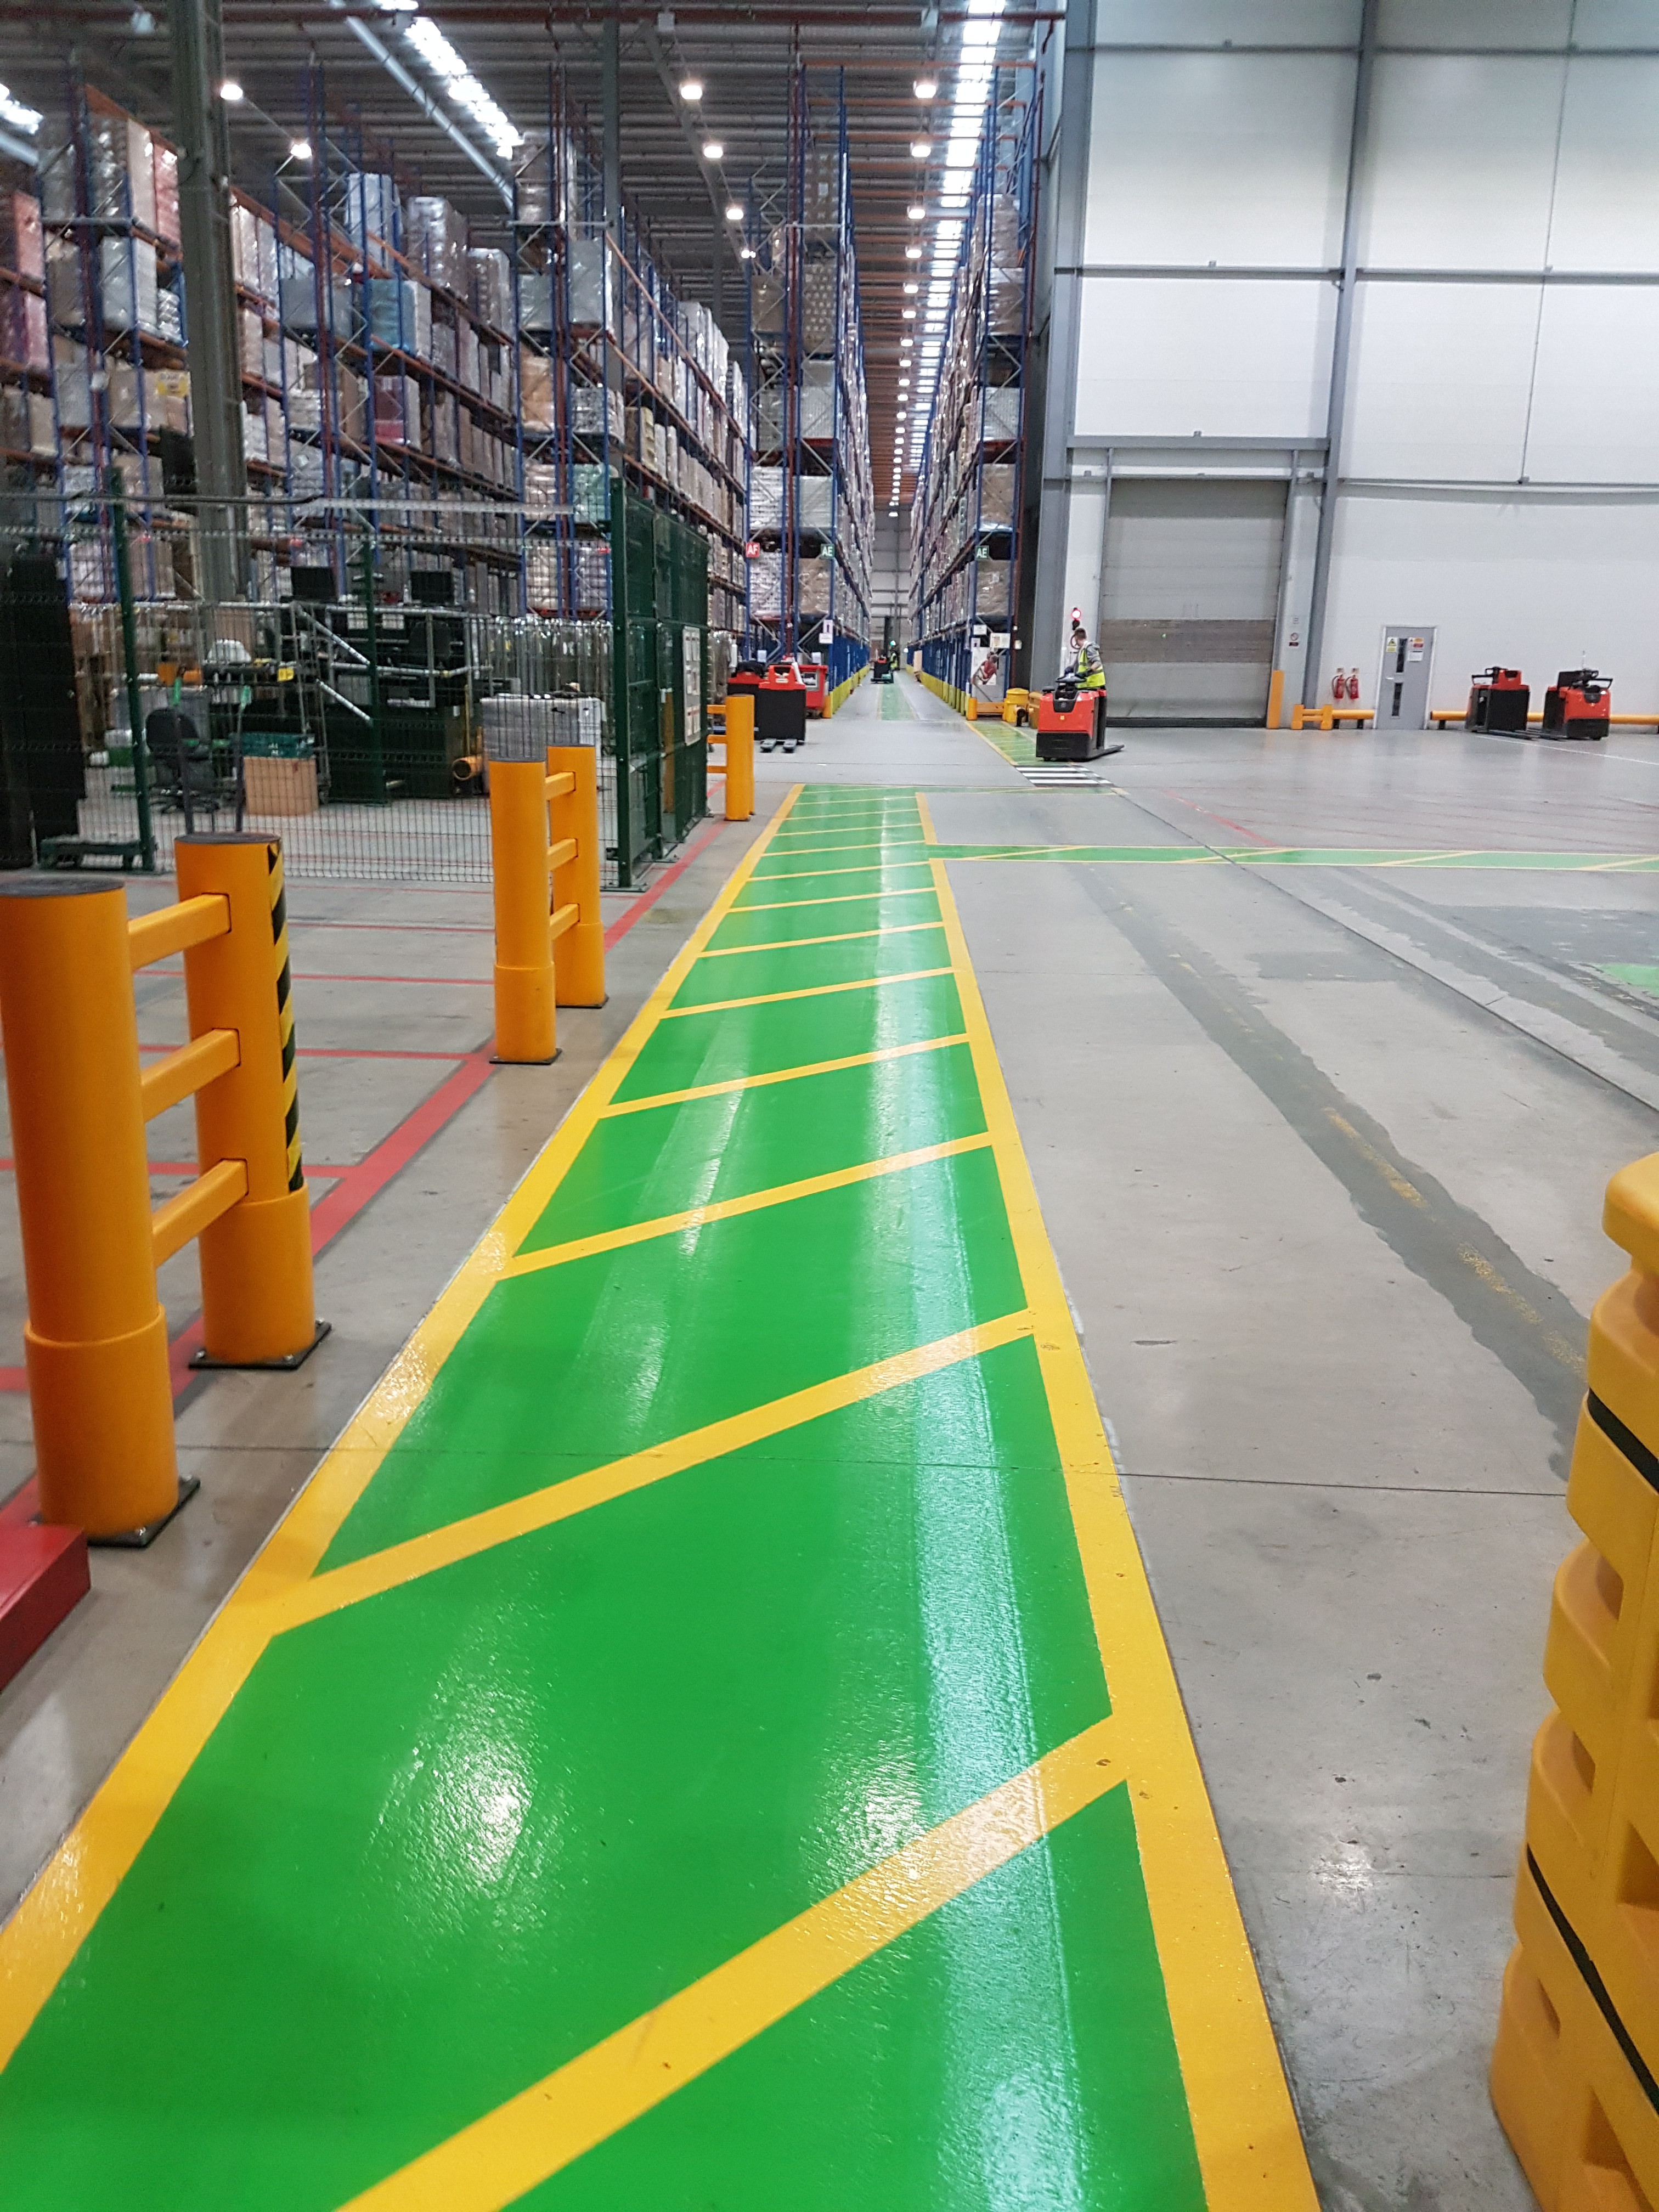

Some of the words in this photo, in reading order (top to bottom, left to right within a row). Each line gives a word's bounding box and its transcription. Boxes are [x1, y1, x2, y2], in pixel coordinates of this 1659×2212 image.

[747, 544, 758, 555] AF
[822, 546, 833, 556] AE
[977, 548, 988, 558] AE
